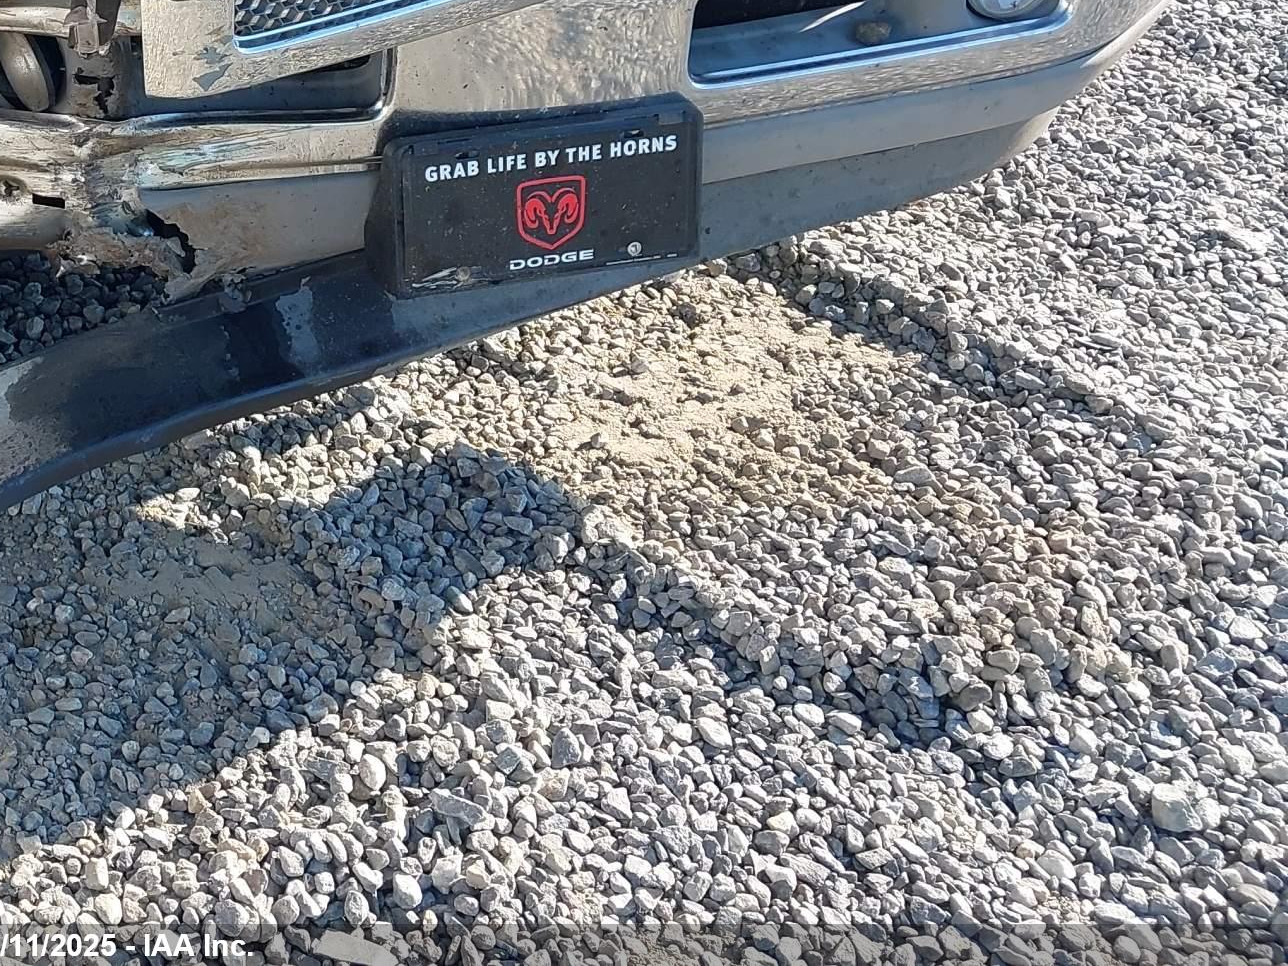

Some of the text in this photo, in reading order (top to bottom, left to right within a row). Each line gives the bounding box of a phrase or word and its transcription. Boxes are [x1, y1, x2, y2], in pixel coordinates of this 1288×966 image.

[424, 134, 677, 183] GRAB LIFE BY THE HORNS
[509, 249, 594, 270] DODGE
